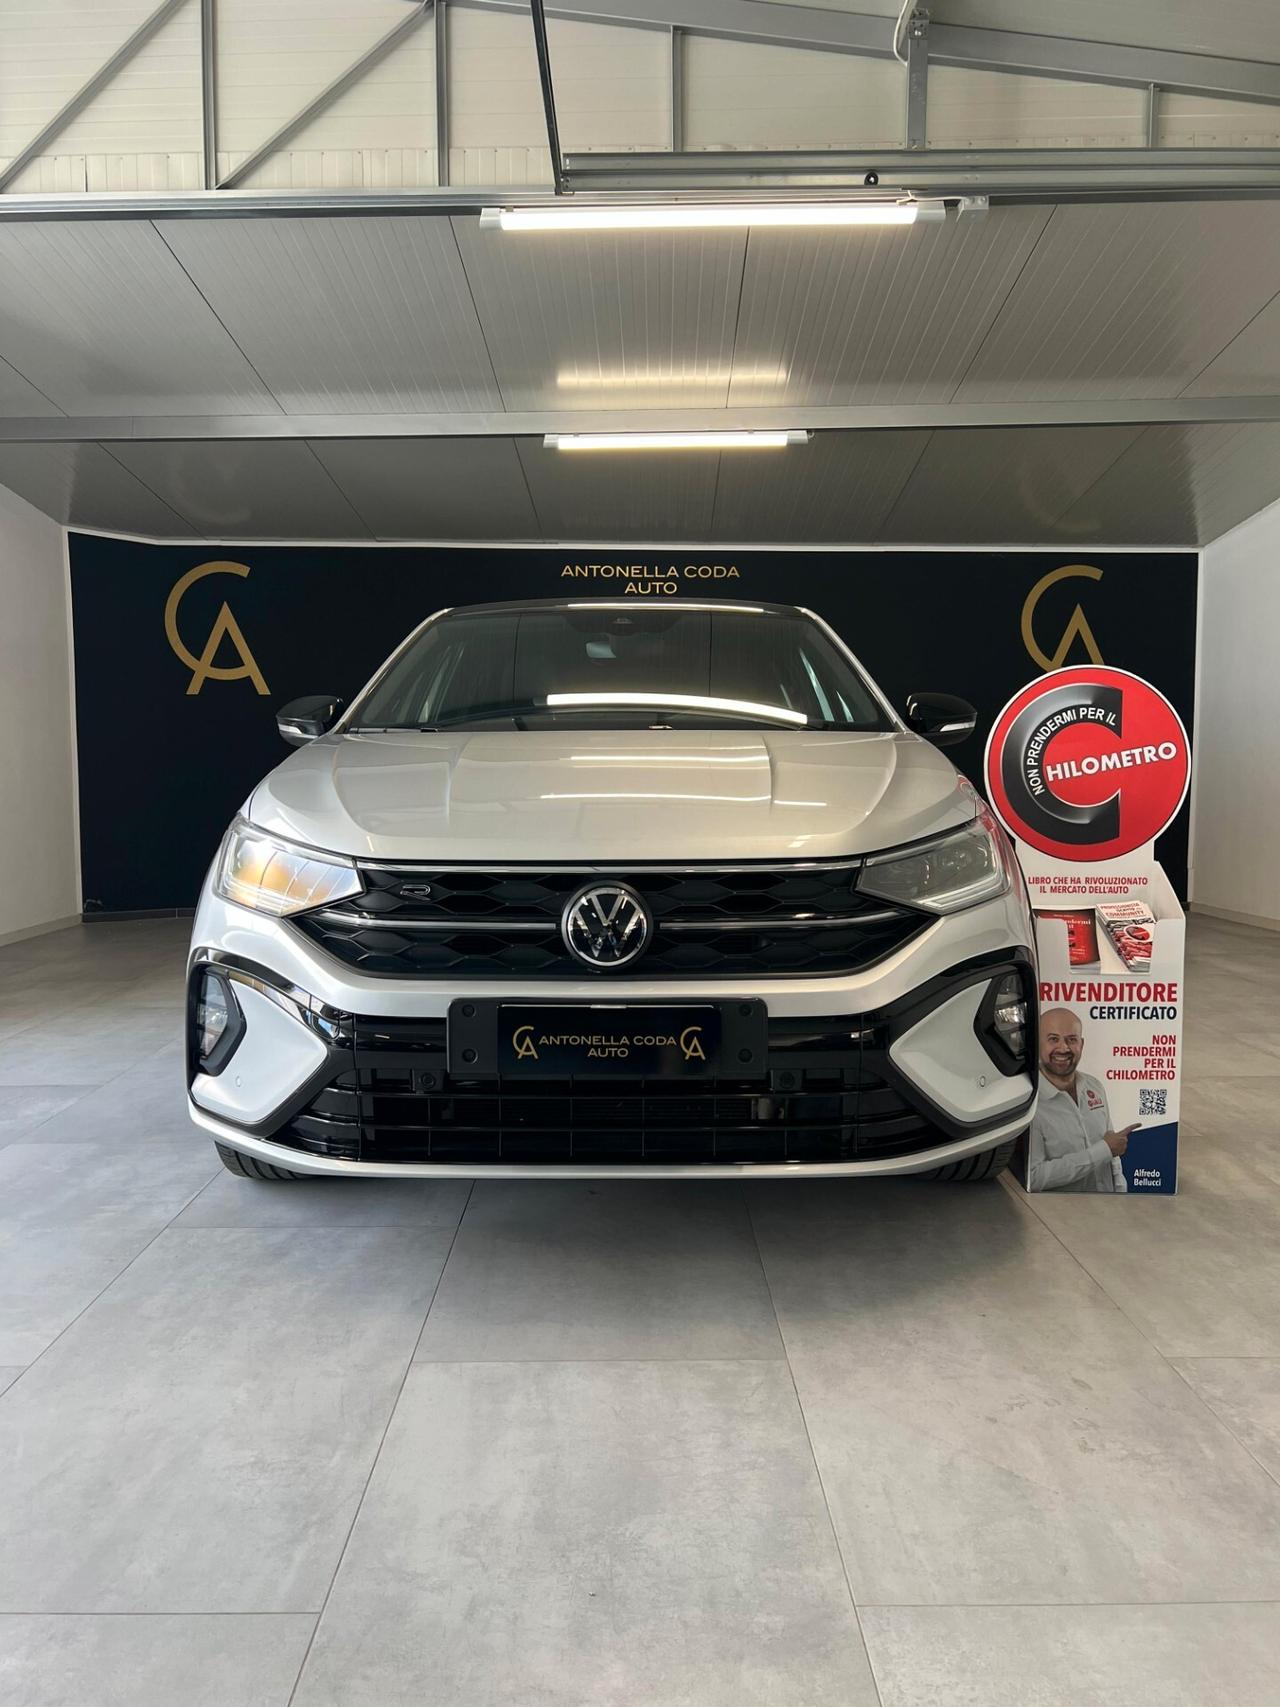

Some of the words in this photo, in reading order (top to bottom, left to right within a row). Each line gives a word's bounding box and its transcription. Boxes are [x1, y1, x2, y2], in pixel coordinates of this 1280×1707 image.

[560, 564, 680, 578] ANTONELLA
[683, 565, 741, 579] CODA
[624, 581, 678, 594] AUTO
[1079, 707, 1105, 721] PER
[1105, 710, 1117, 727] IL
[1026, 708, 1077, 766] PRENDERMI
[1026, 769, 1046, 796] NON
[1027, 876, 1051, 886] LIBRO
[1052, 876, 1069, 886] CHE
[1070, 876, 1082, 886] HA
[1084, 876, 1148, 886] RIVOLUZIONATO
[1039, 885, 1047, 894] IL
[1050, 885, 1088, 894] MERCATO
[1088, 885, 1129, 894] DELL'AUTO
[1039, 982, 1178, 1003] RIVENDITORE
[1089, 1005, 1177, 1020] CERTIFICATO
[538, 1035, 630, 1046] ANTONELLA
[633, 1035, 677, 1046] CODA
[1152, 1034, 1177, 1045] NON
[587, 1047, 629, 1058] AUTO
[1112, 1046, 1176, 1057] PRENDERMI
[1144, 1058, 1164, 1069] PER
[1166, 1058, 1176, 1069] IL
[1106, 1069, 1176, 1081] CHILOMETRO
[1133, 1168, 1161, 1178] Alfredo
[1133, 1178, 1161, 1187] Bellucci
